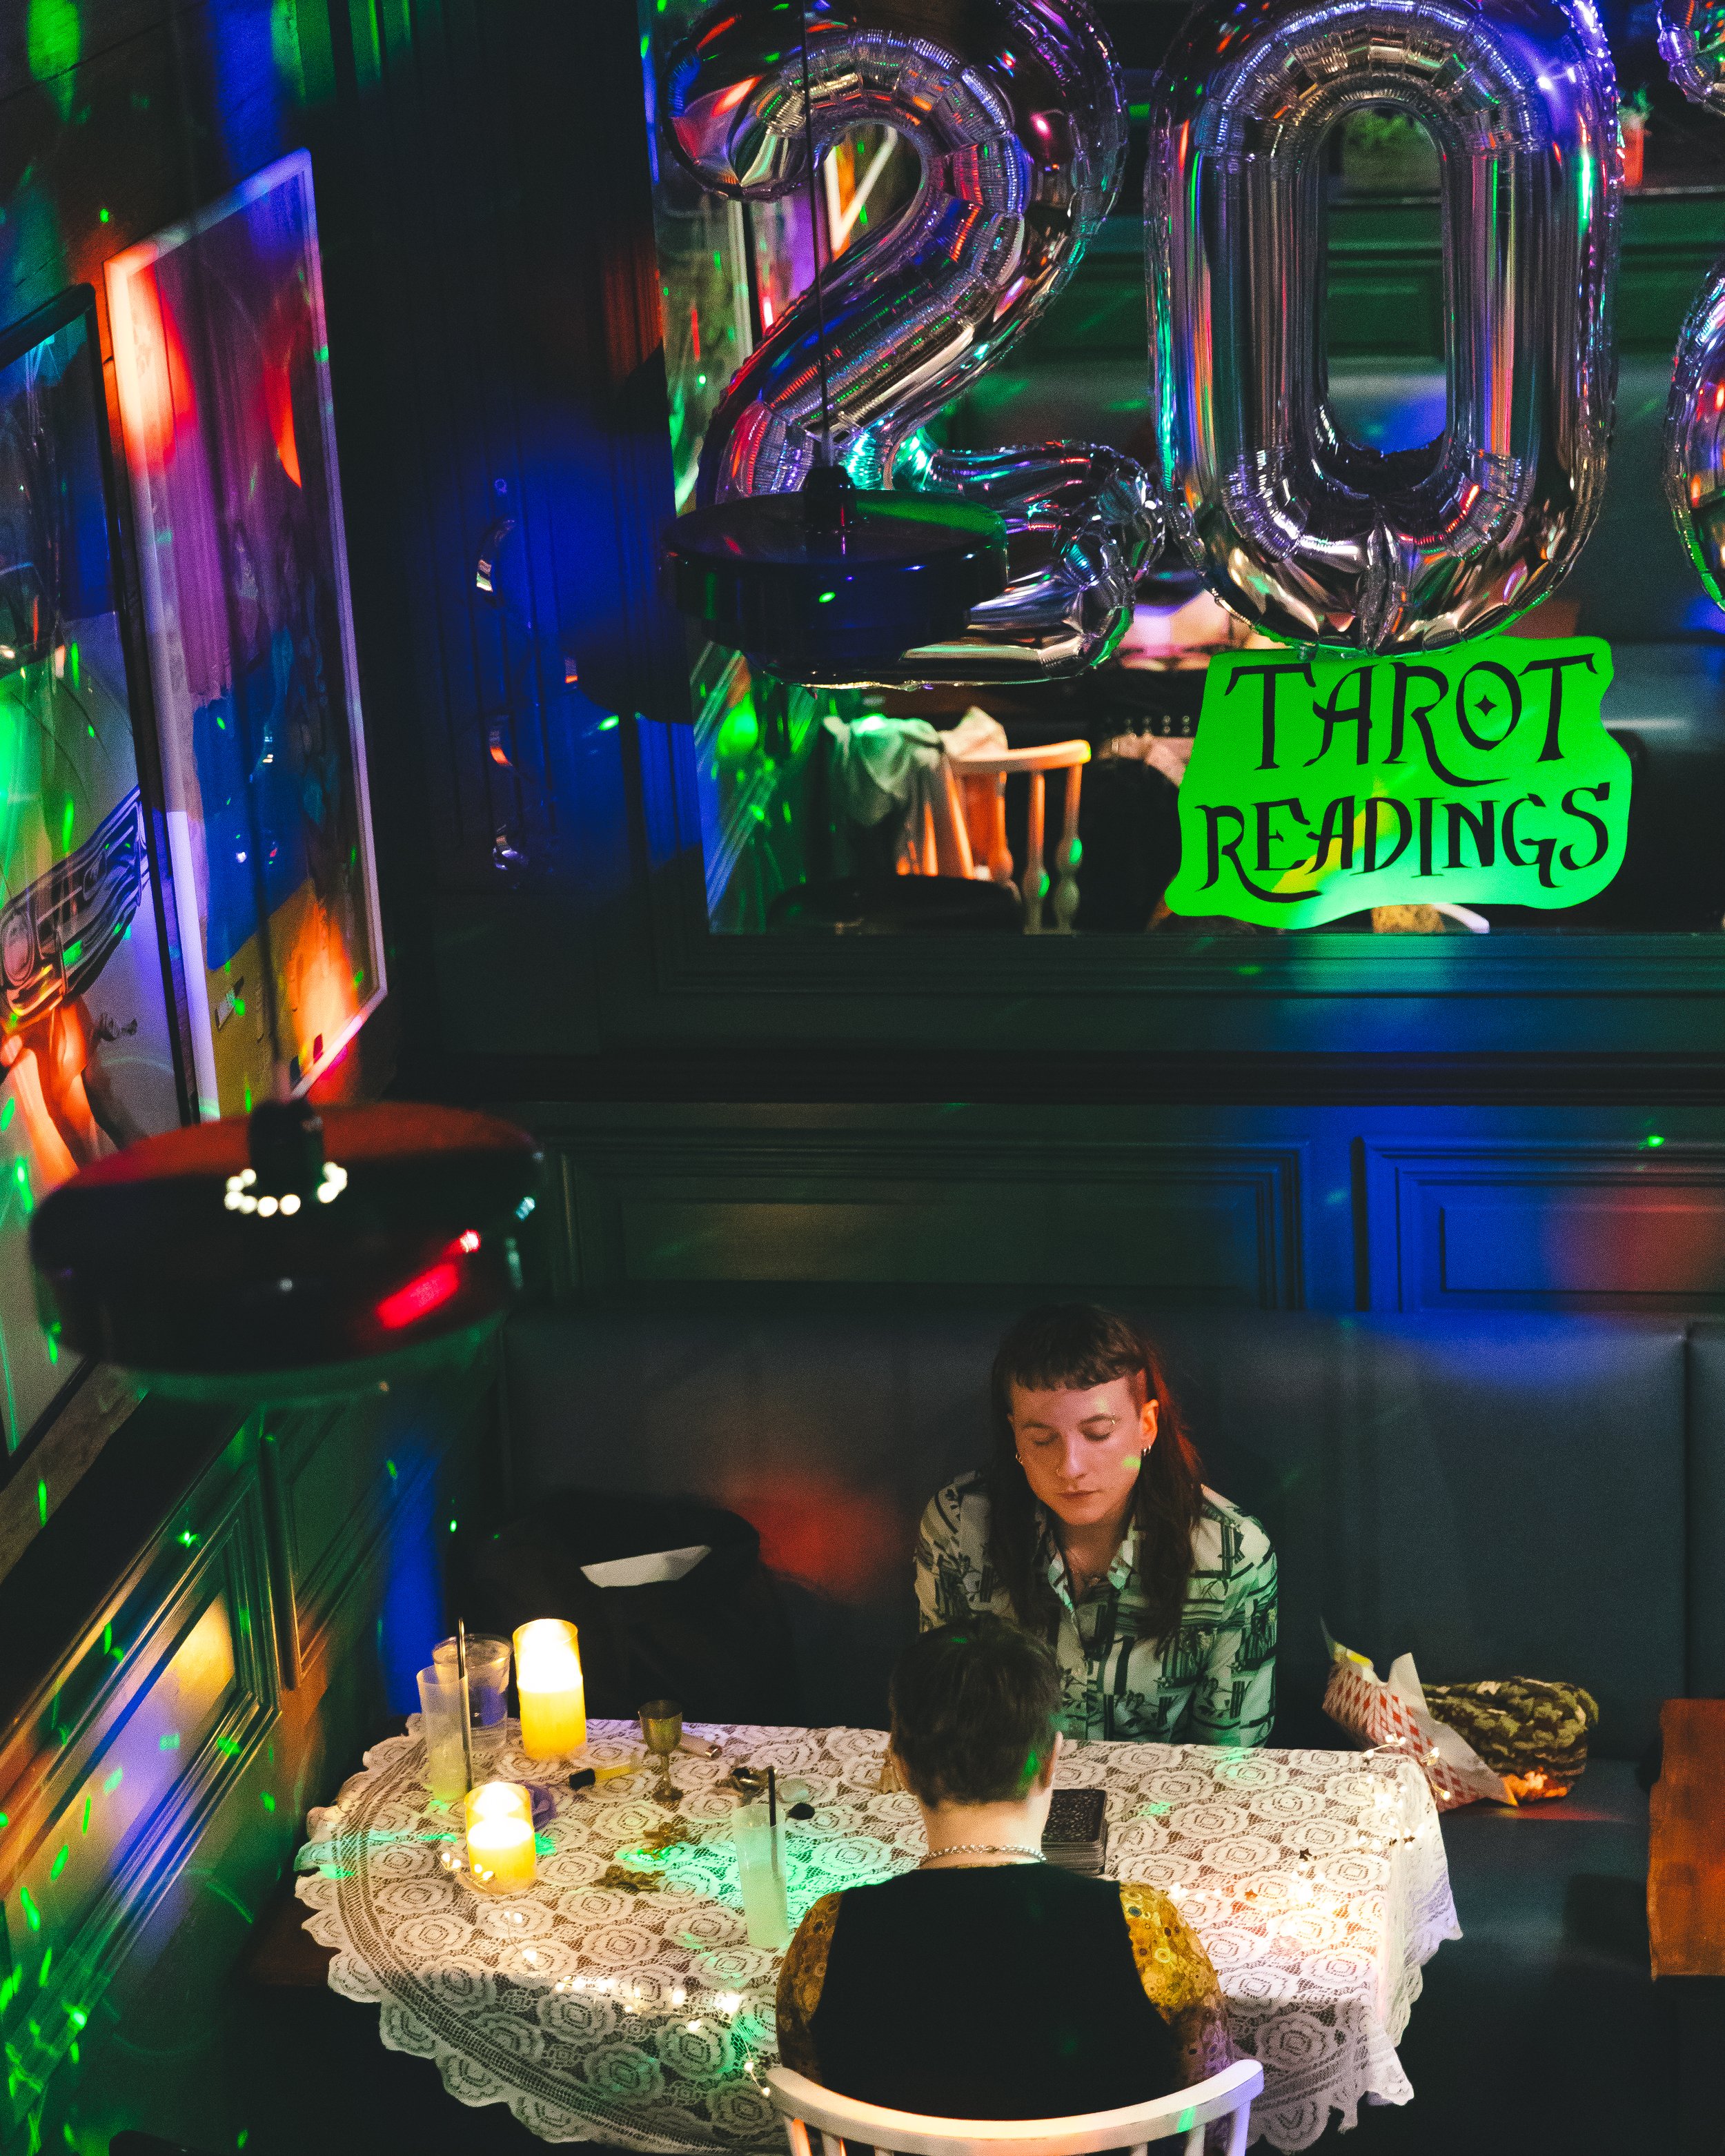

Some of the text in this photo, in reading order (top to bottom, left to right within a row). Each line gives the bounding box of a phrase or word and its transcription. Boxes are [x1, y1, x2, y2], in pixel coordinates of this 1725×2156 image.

[662, 0, 1725, 689] 20
[1224, 653, 1598, 788] TAROT
[1194, 781, 1611, 904] READINGS
